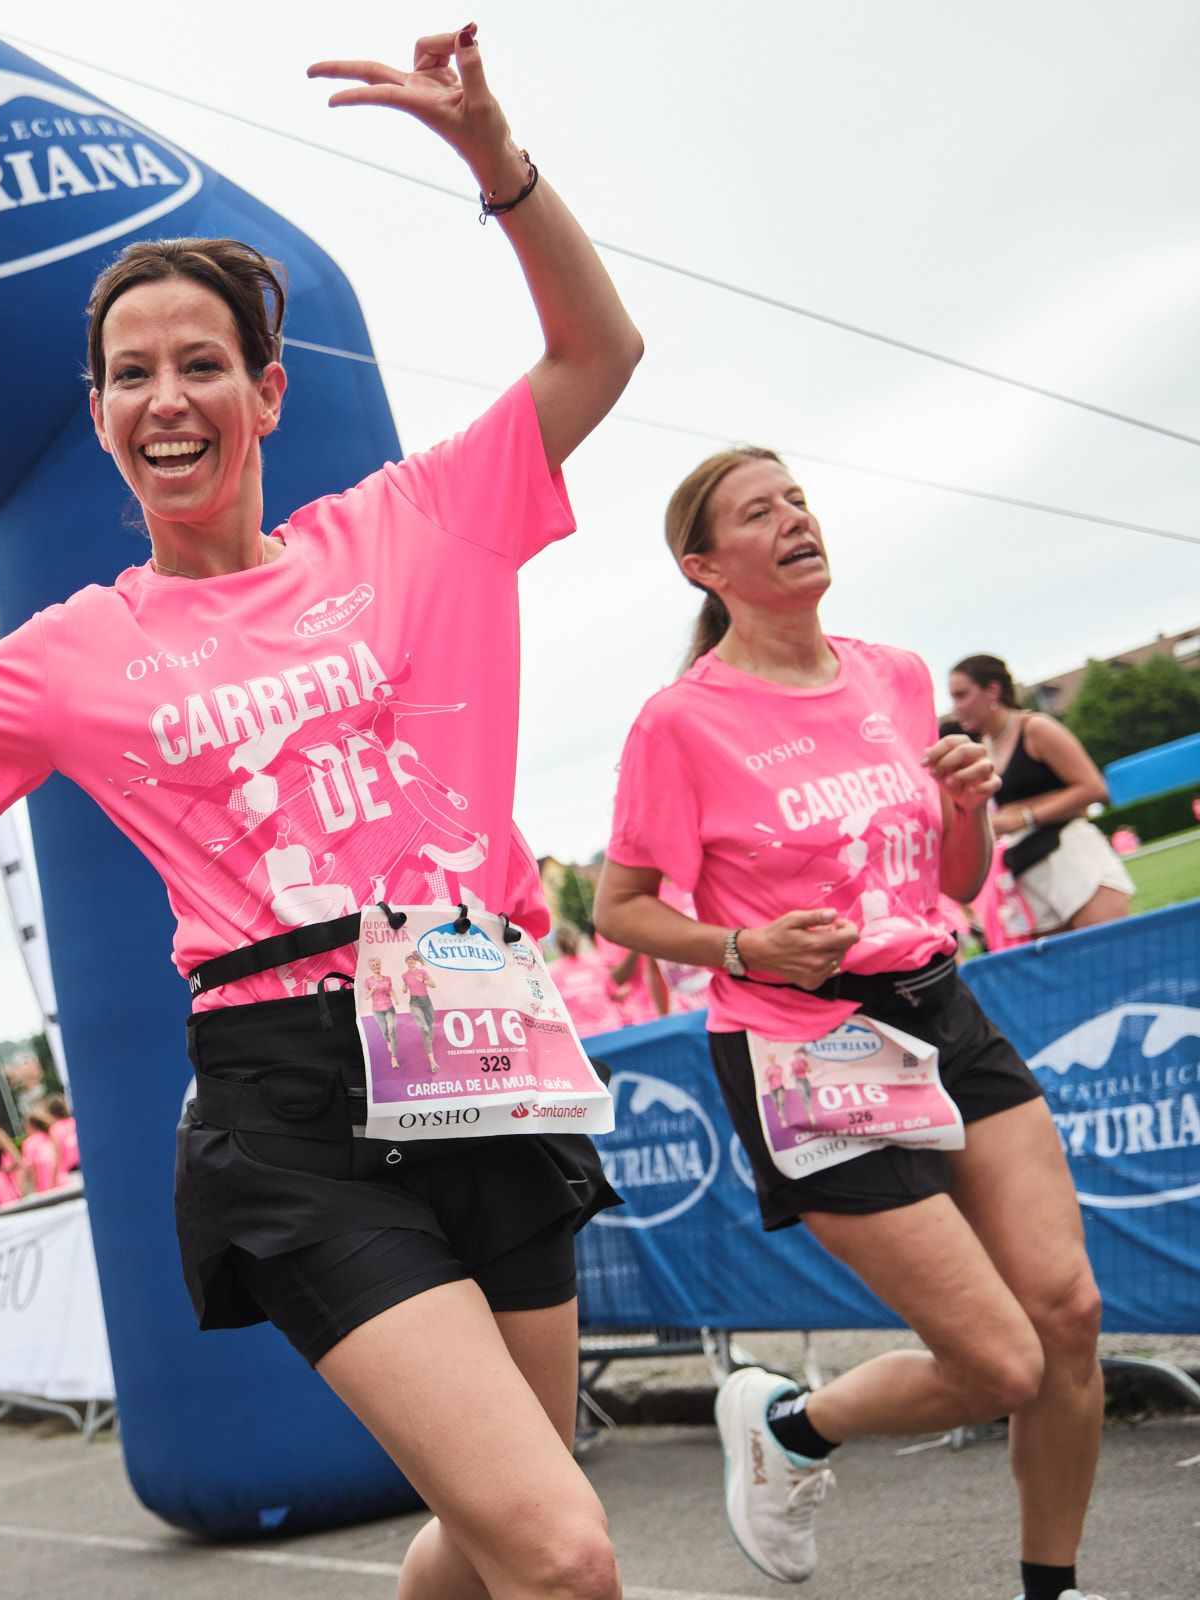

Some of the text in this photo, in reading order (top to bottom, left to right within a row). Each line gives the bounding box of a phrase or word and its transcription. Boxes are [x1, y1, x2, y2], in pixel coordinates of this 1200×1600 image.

[303, 591, 370, 635] ASTURIANA
[125, 637, 218, 681] OYSHO
[150, 641, 393, 767] CARRERA
[745, 736, 816, 772] OYSHO
[302, 730, 392, 835] DE
[778, 760, 922, 832] CARRERA
[882, 820, 921, 888] DE
[365, 929, 412, 945] SUMA
[443, 1009, 527, 1048] 016
[480, 1055, 511, 1073] 329
[406, 1079, 464, 1097] CARRERA
[467, 1078, 482, 1092] DE
[484, 1077, 501, 1091] LA
[817, 1083, 889, 1111] 016
[399, 1103, 587, 1129] OYSHO Santander
[848, 1111, 873, 1125] 326
[795, 1138, 848, 1168] OYSHO
